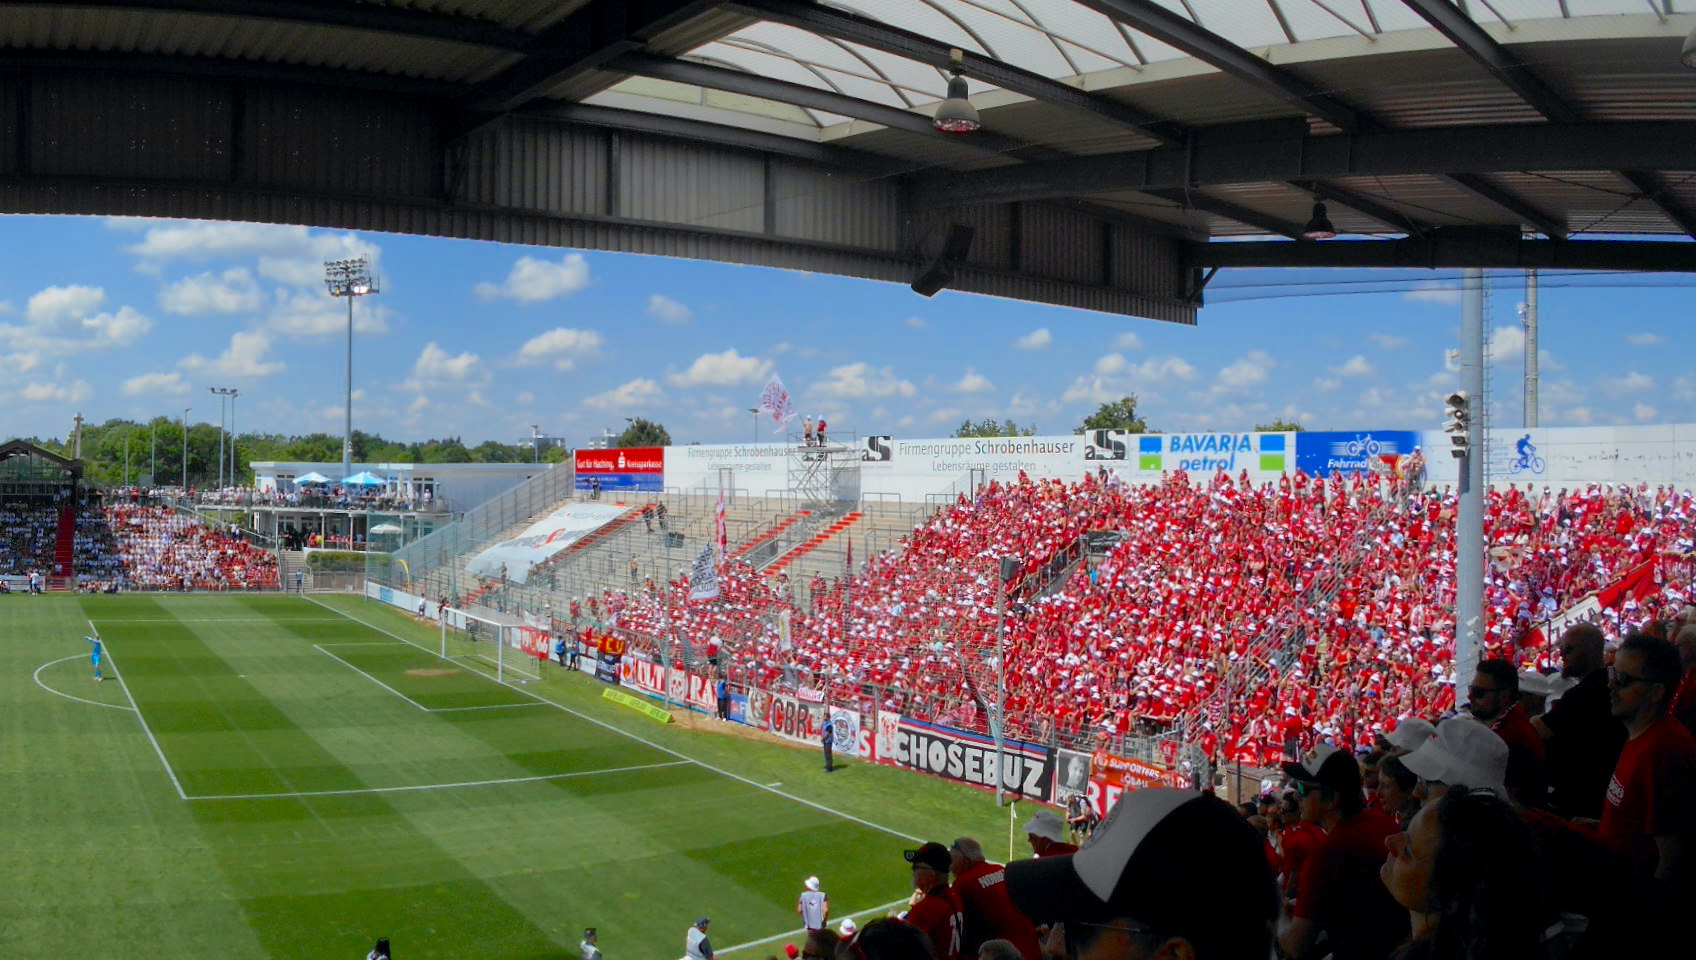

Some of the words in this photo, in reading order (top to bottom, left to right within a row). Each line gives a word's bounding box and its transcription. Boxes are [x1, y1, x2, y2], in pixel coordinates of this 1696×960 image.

[898, 441, 972, 462] Firmengruppe
[974, 440, 1075, 456] Schrobenhauser
[1170, 434, 1251, 452] BAVARIA
[688, 447, 733, 463] Firmengruppe
[734, 446, 795, 459] Schrobenhauser
[1179, 450, 1234, 473] petrol
[1327, 457, 1368, 468] Fahrrad
[577, 459, 586, 469] Gut
[627, 460, 663, 471] Kreissparkasse
[932, 461, 991, 472] Lebensräume
[993, 460, 1036, 473] gestalten
[772, 698, 809, 740] CBR
[895, 730, 1045, 798] CHOŚEBUZ
[1109, 758, 1160, 779] SUPPORTERS
